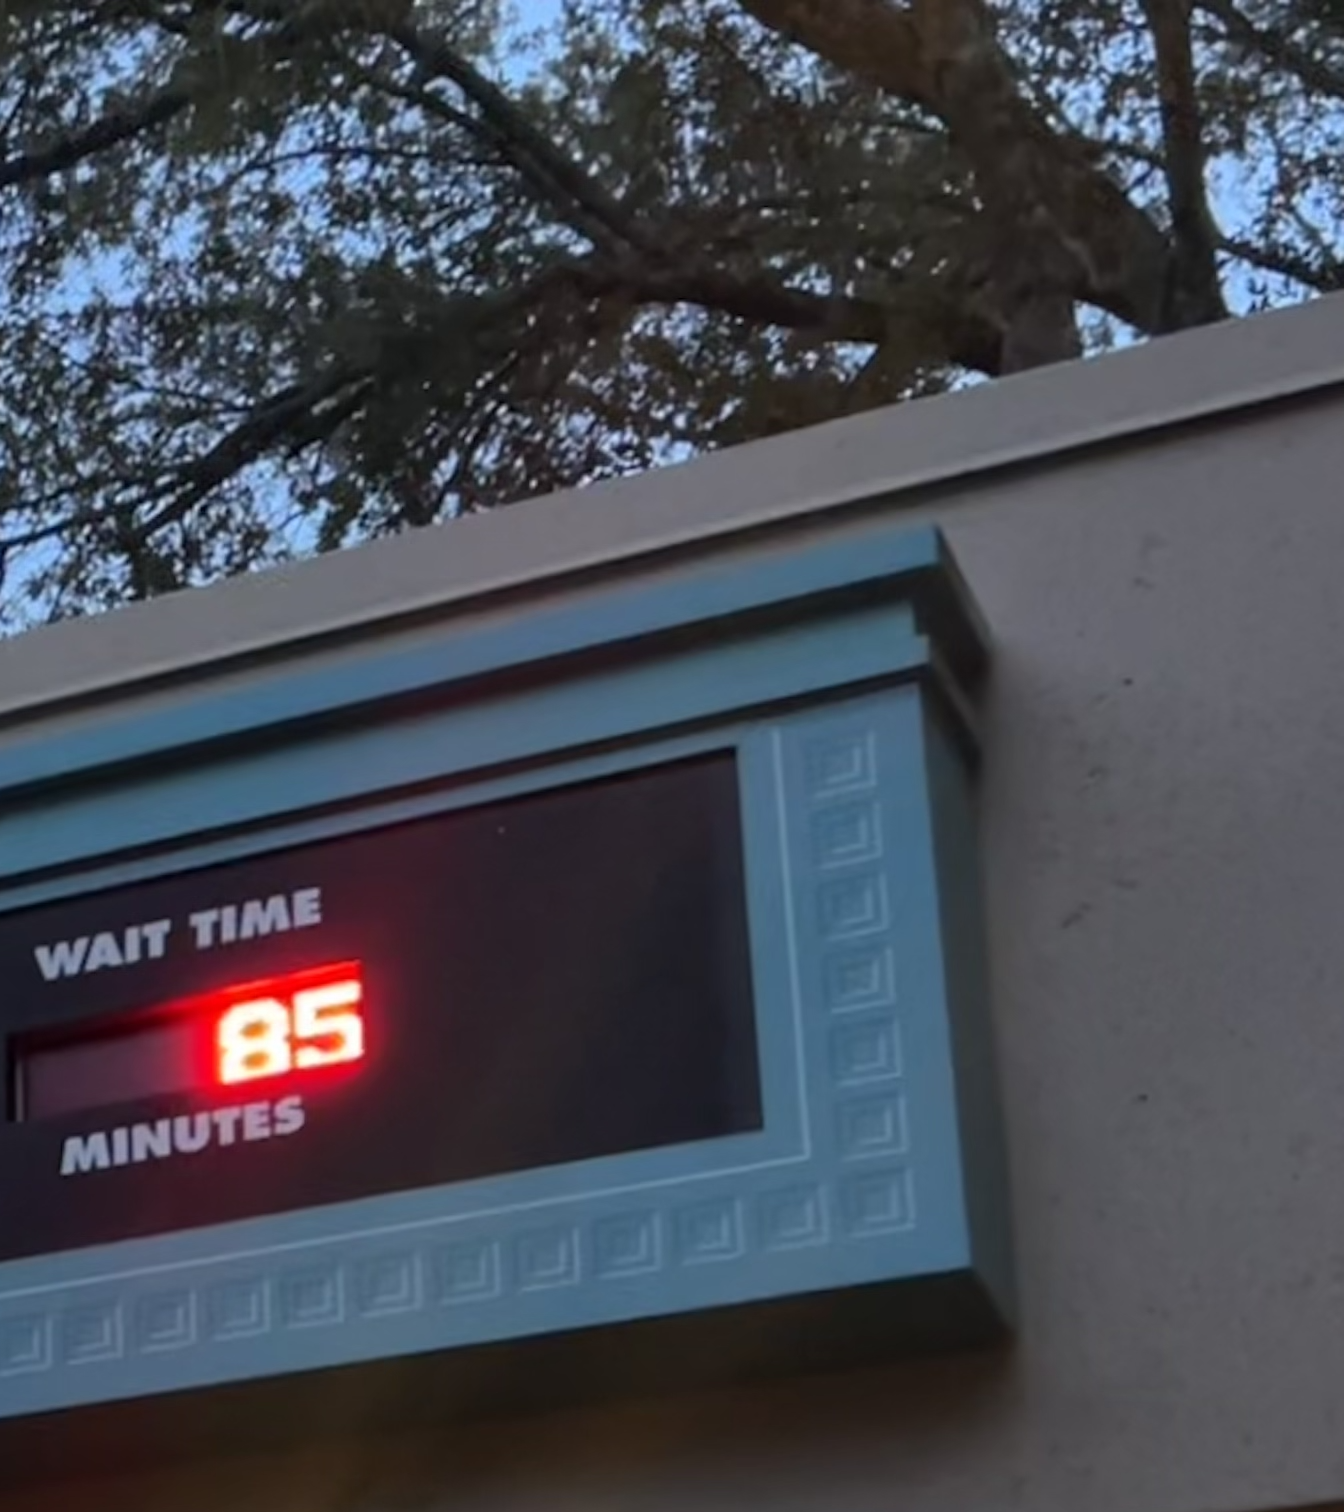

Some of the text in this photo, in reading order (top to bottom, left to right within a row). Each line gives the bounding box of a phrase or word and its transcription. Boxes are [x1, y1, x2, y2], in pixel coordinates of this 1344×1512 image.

[35, 887, 322, 981] WAIT TIME
[217, 979, 365, 1086] 85
[60, 1095, 306, 1176] MINUTES
